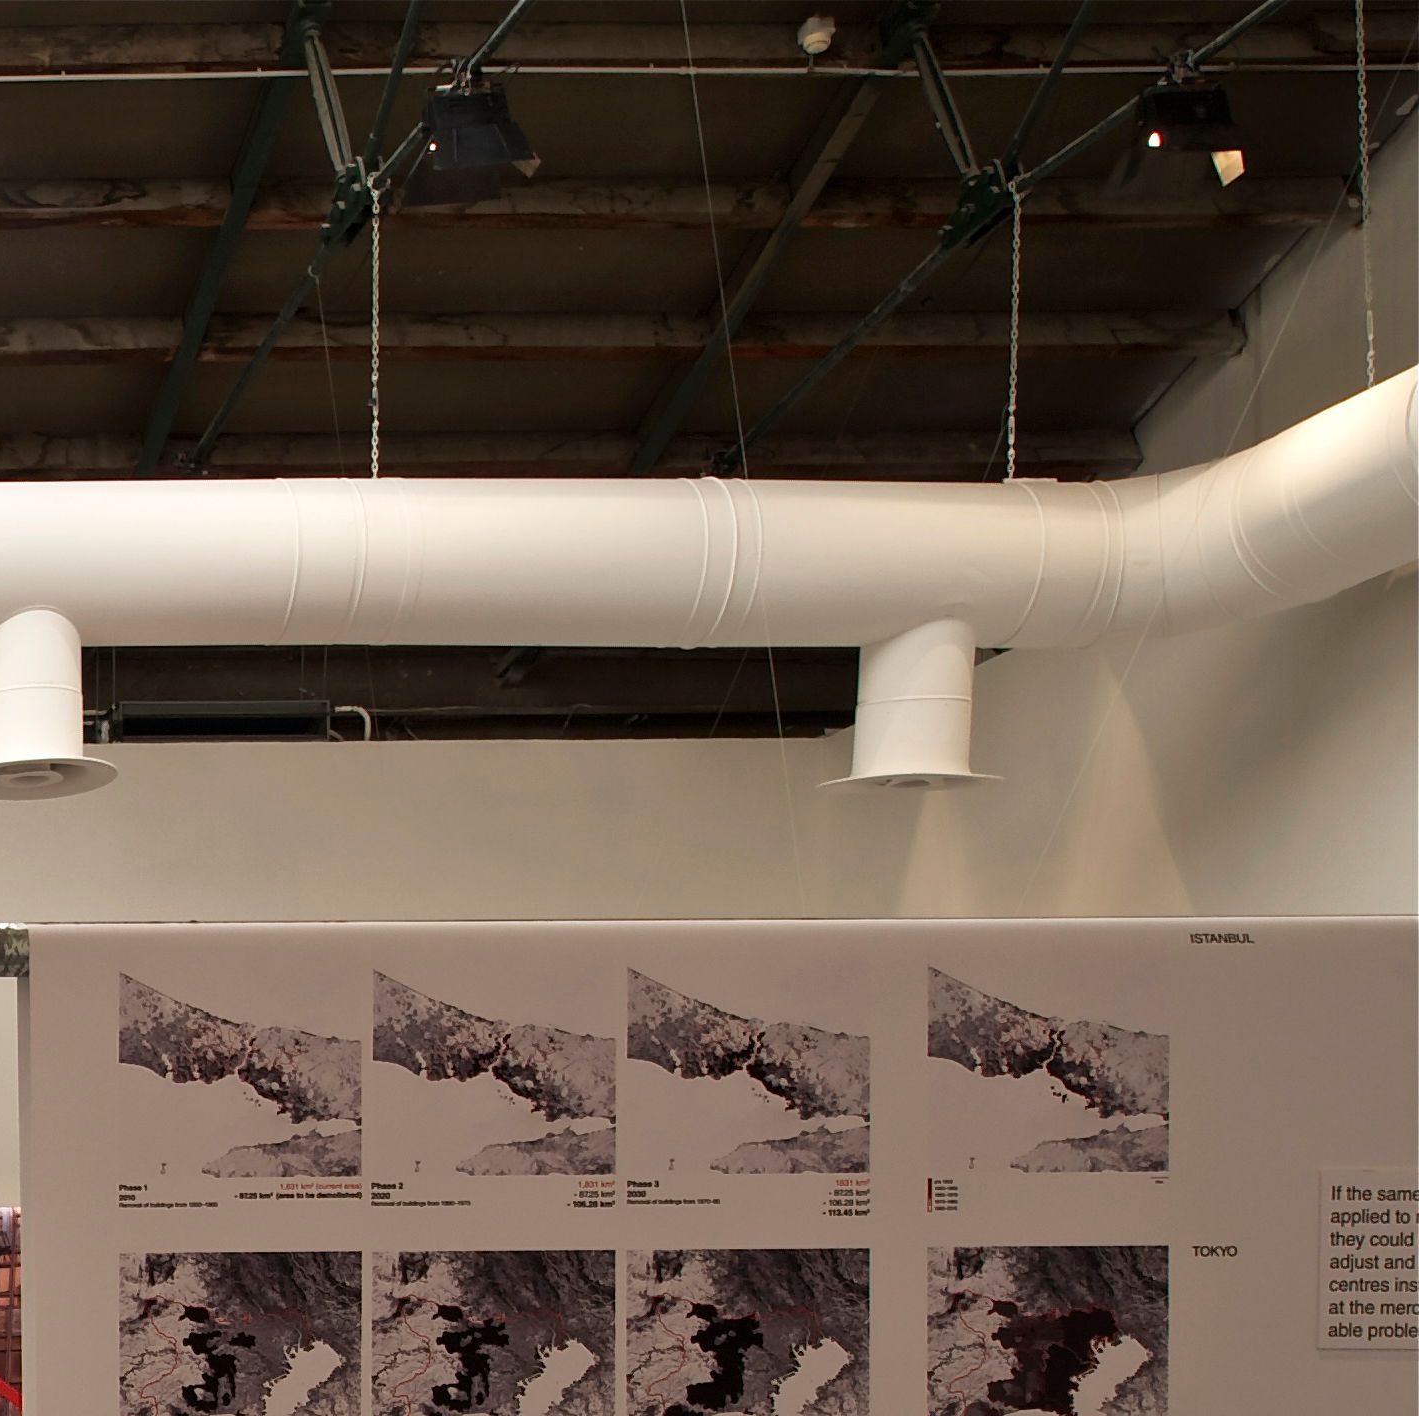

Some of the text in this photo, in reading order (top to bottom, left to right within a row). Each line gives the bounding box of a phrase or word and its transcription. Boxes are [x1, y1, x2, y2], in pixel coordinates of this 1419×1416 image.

[1190, 933, 1255, 944] ISTANBUL
[118, 1183, 143, 1192] Phase
[370, 1182, 397, 1190] Phase
[626, 1180, 653, 1188] Phase
[1331, 1186, 1342, 1200] If
[1347, 1186, 1372, 1201] the
[1331, 1209, 1390, 1227] applied
[1395, 1210, 1410, 1224] to
[1330, 1232, 1414, 1250] they could
[1192, 1246, 1237, 1257] TOKYO
[1330, 1254, 1415, 1273] adjust and
[1329, 1277, 1419, 1292] centres ins
[1329, 1300, 1419, 1315] at the merc
[1328, 1322, 1419, 1342] able proble
